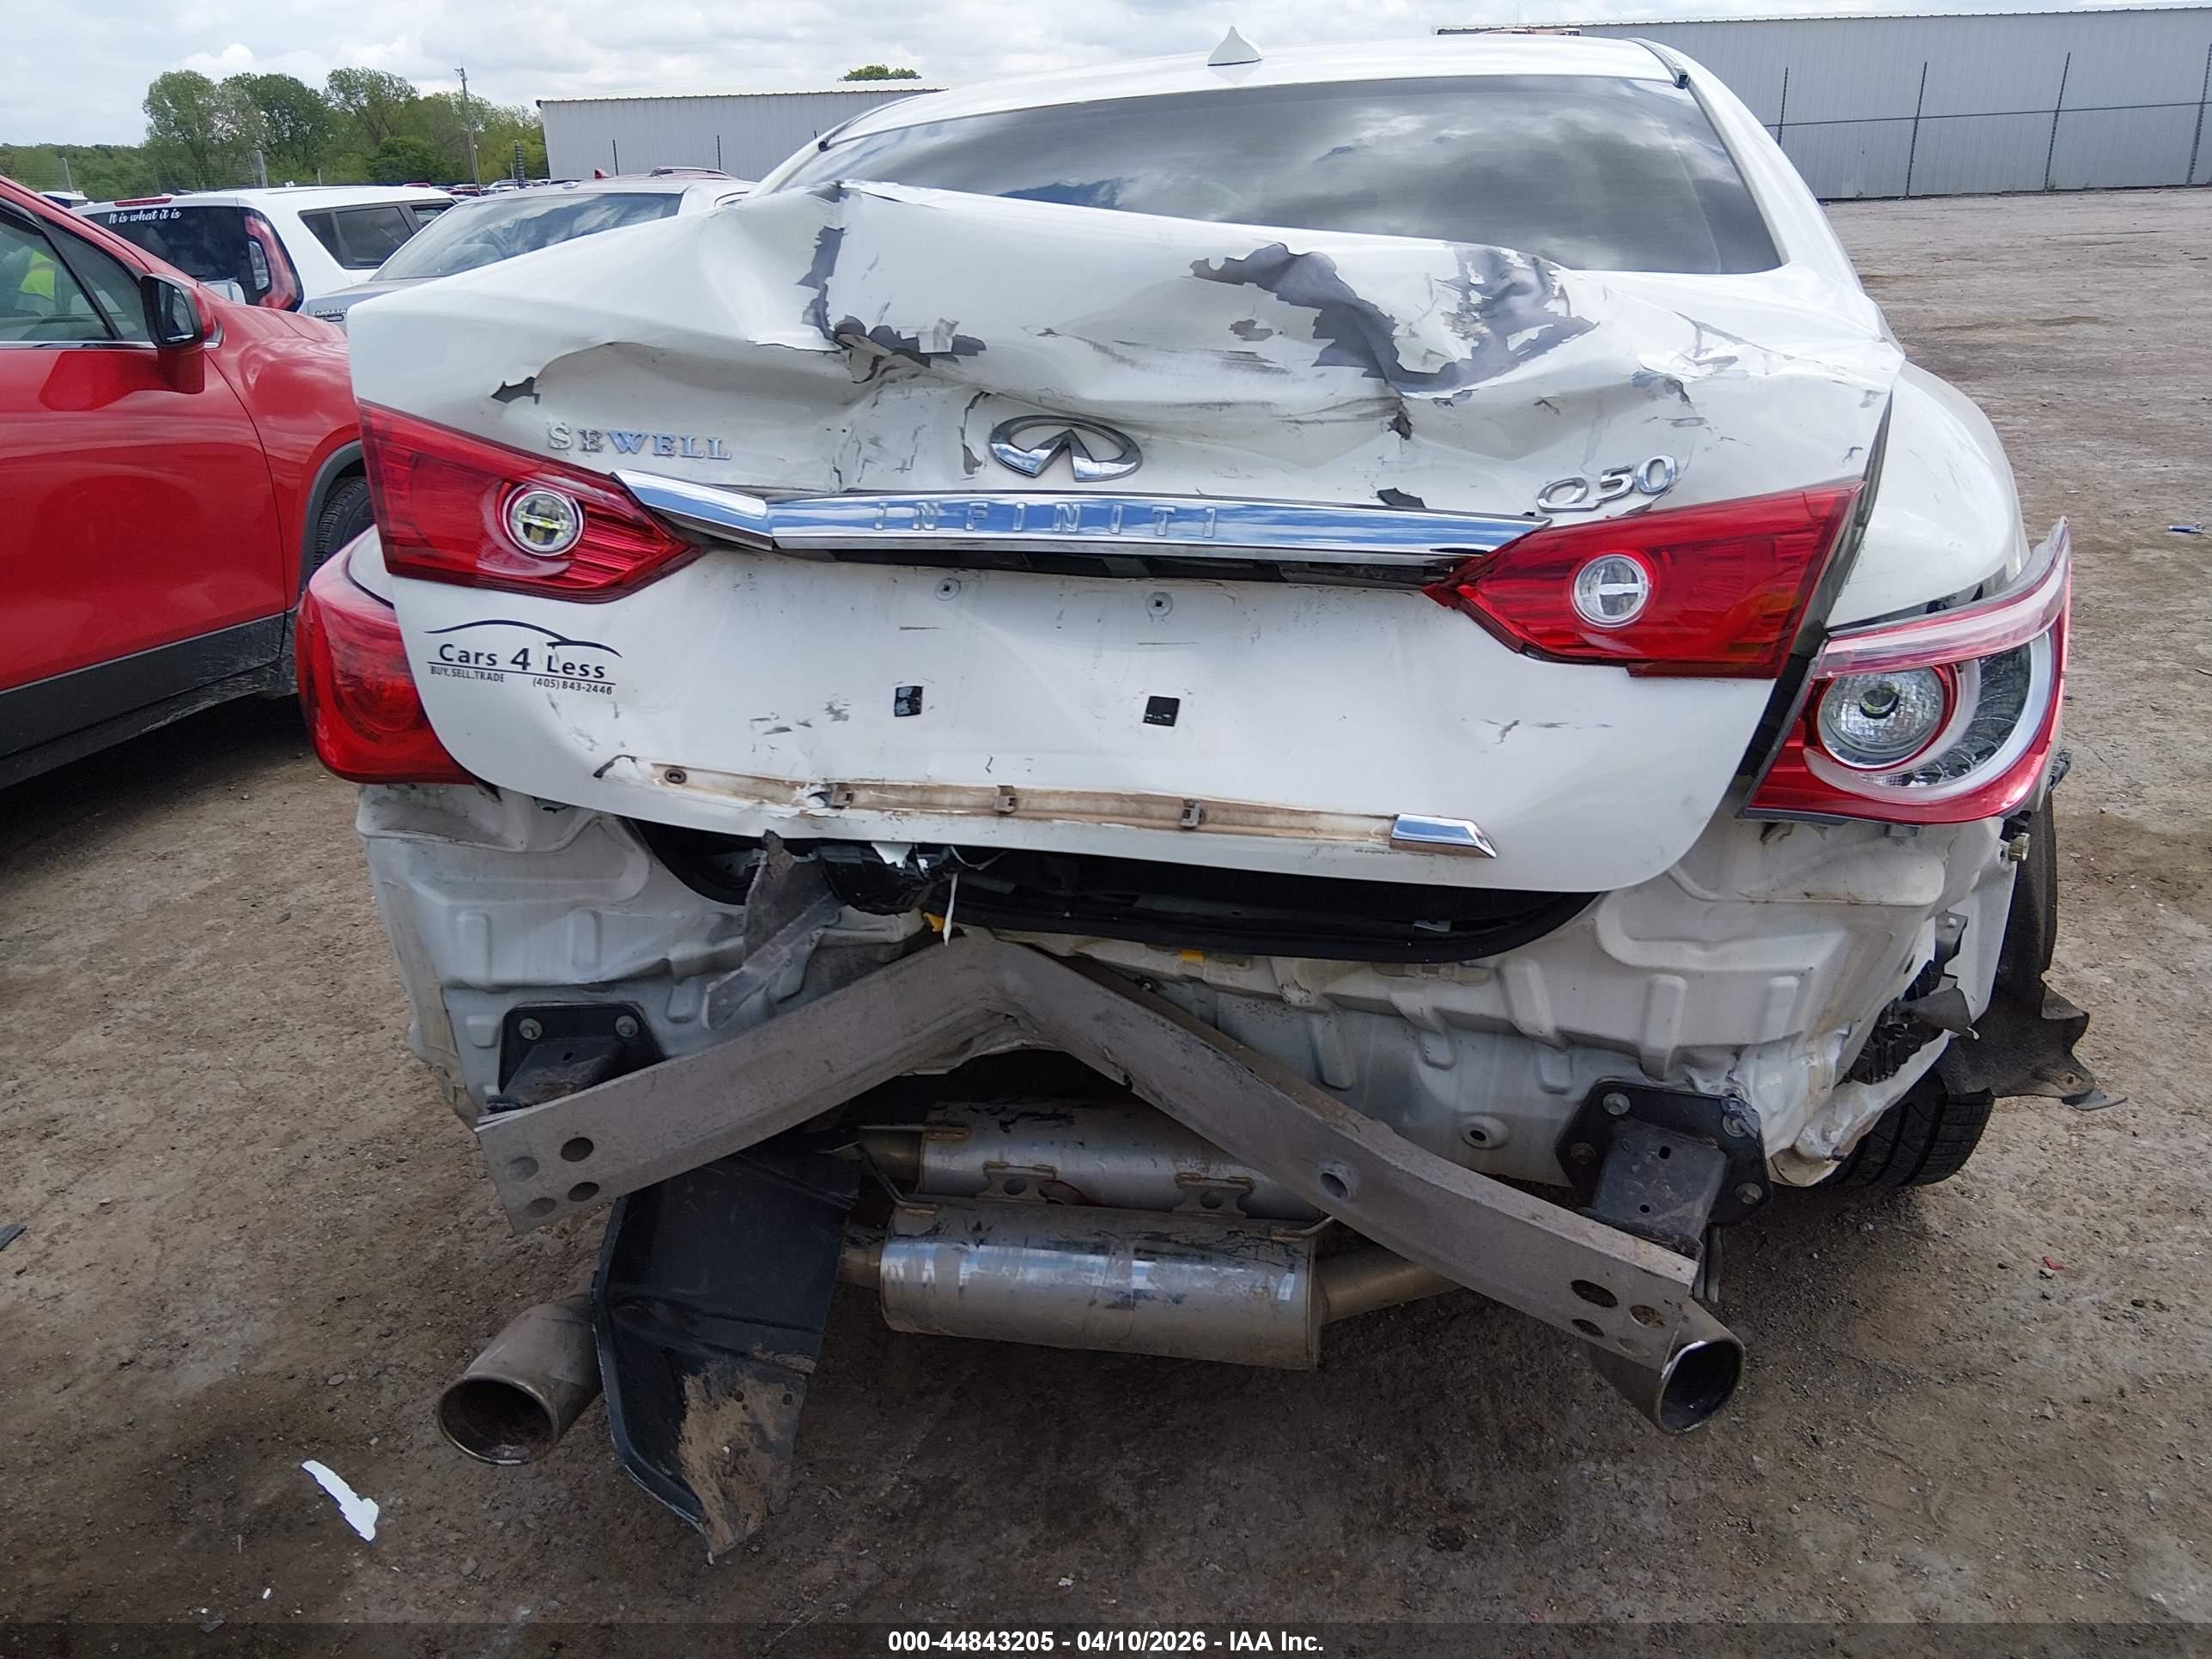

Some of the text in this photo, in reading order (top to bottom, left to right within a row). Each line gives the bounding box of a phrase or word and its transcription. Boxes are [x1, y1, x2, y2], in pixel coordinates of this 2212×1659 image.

[108, 209, 182, 224] It is what it is
[549, 424, 732, 460] SEWELL
[1536, 454, 1677, 514] Q50
[874, 501, 1217, 538] INFINITI
[440, 643, 605, 678] Cars 4 Less
[532, 678, 612, 695] (405) 843-2446
